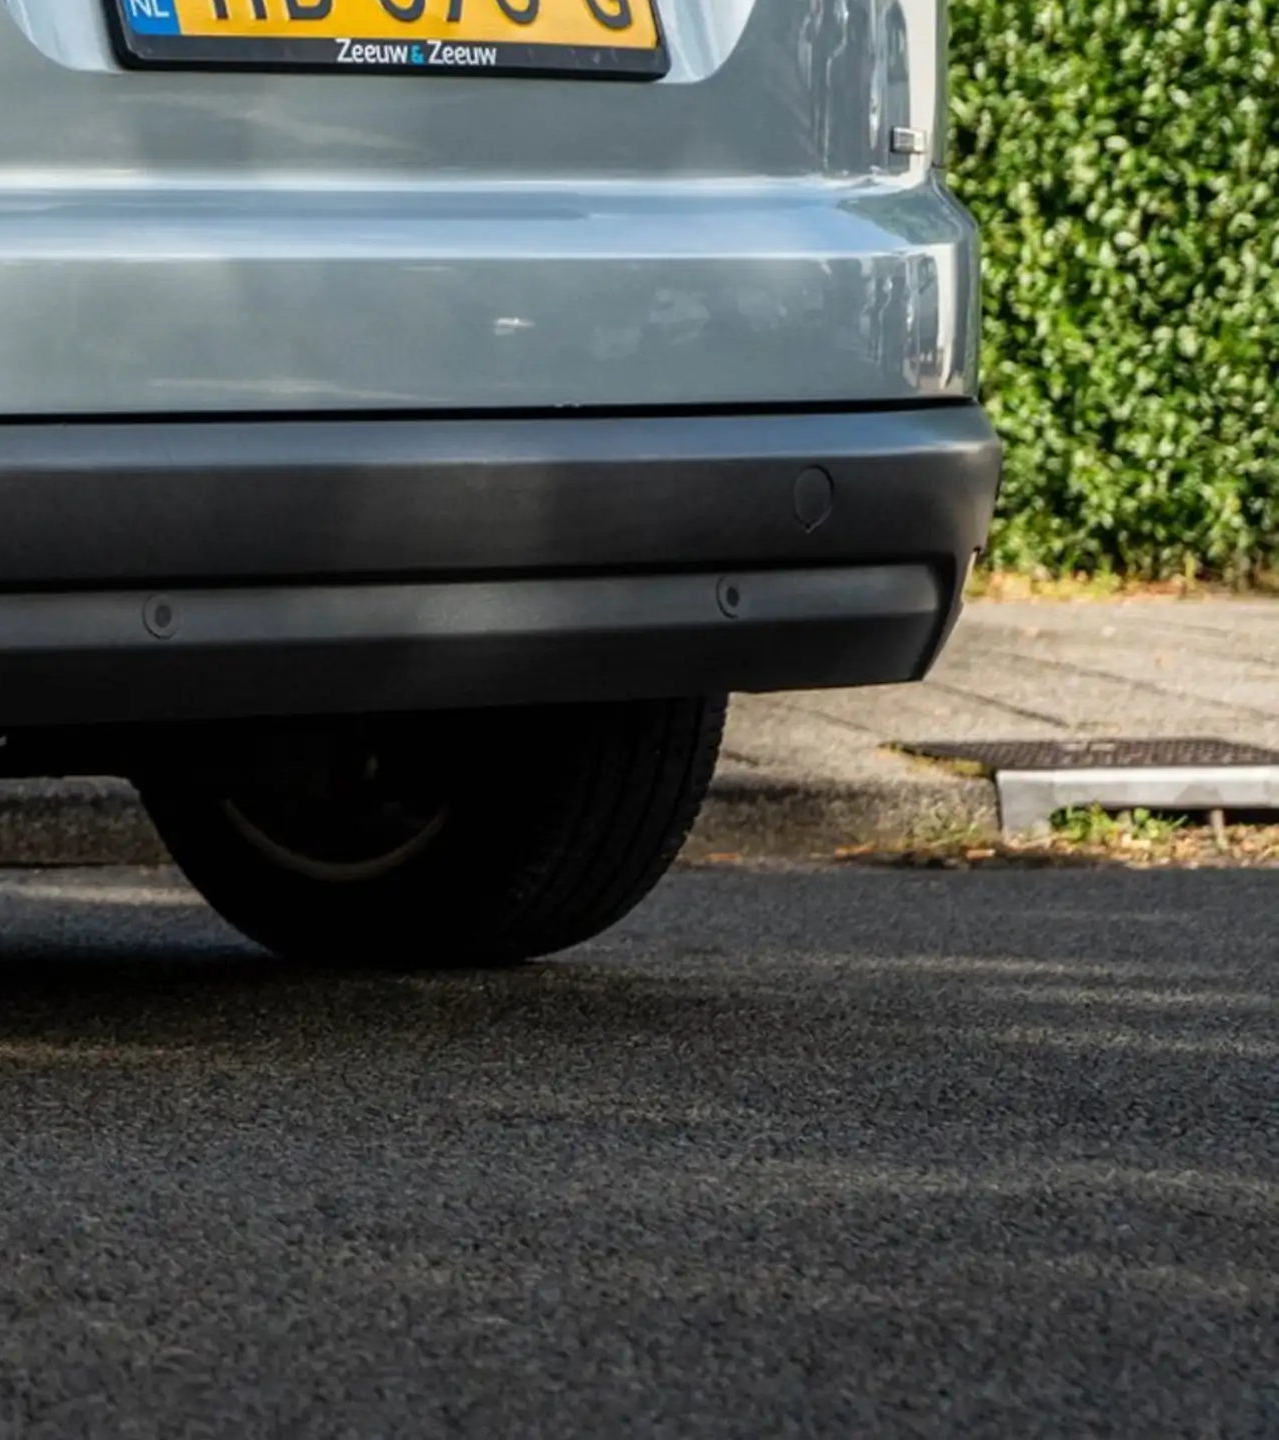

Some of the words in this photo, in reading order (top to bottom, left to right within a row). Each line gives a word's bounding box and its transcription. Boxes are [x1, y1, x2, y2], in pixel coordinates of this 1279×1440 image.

[335, 37, 408, 64] Zeeuw
[410, 44, 425, 65] &
[426, 38, 498, 66] Zeeuw
